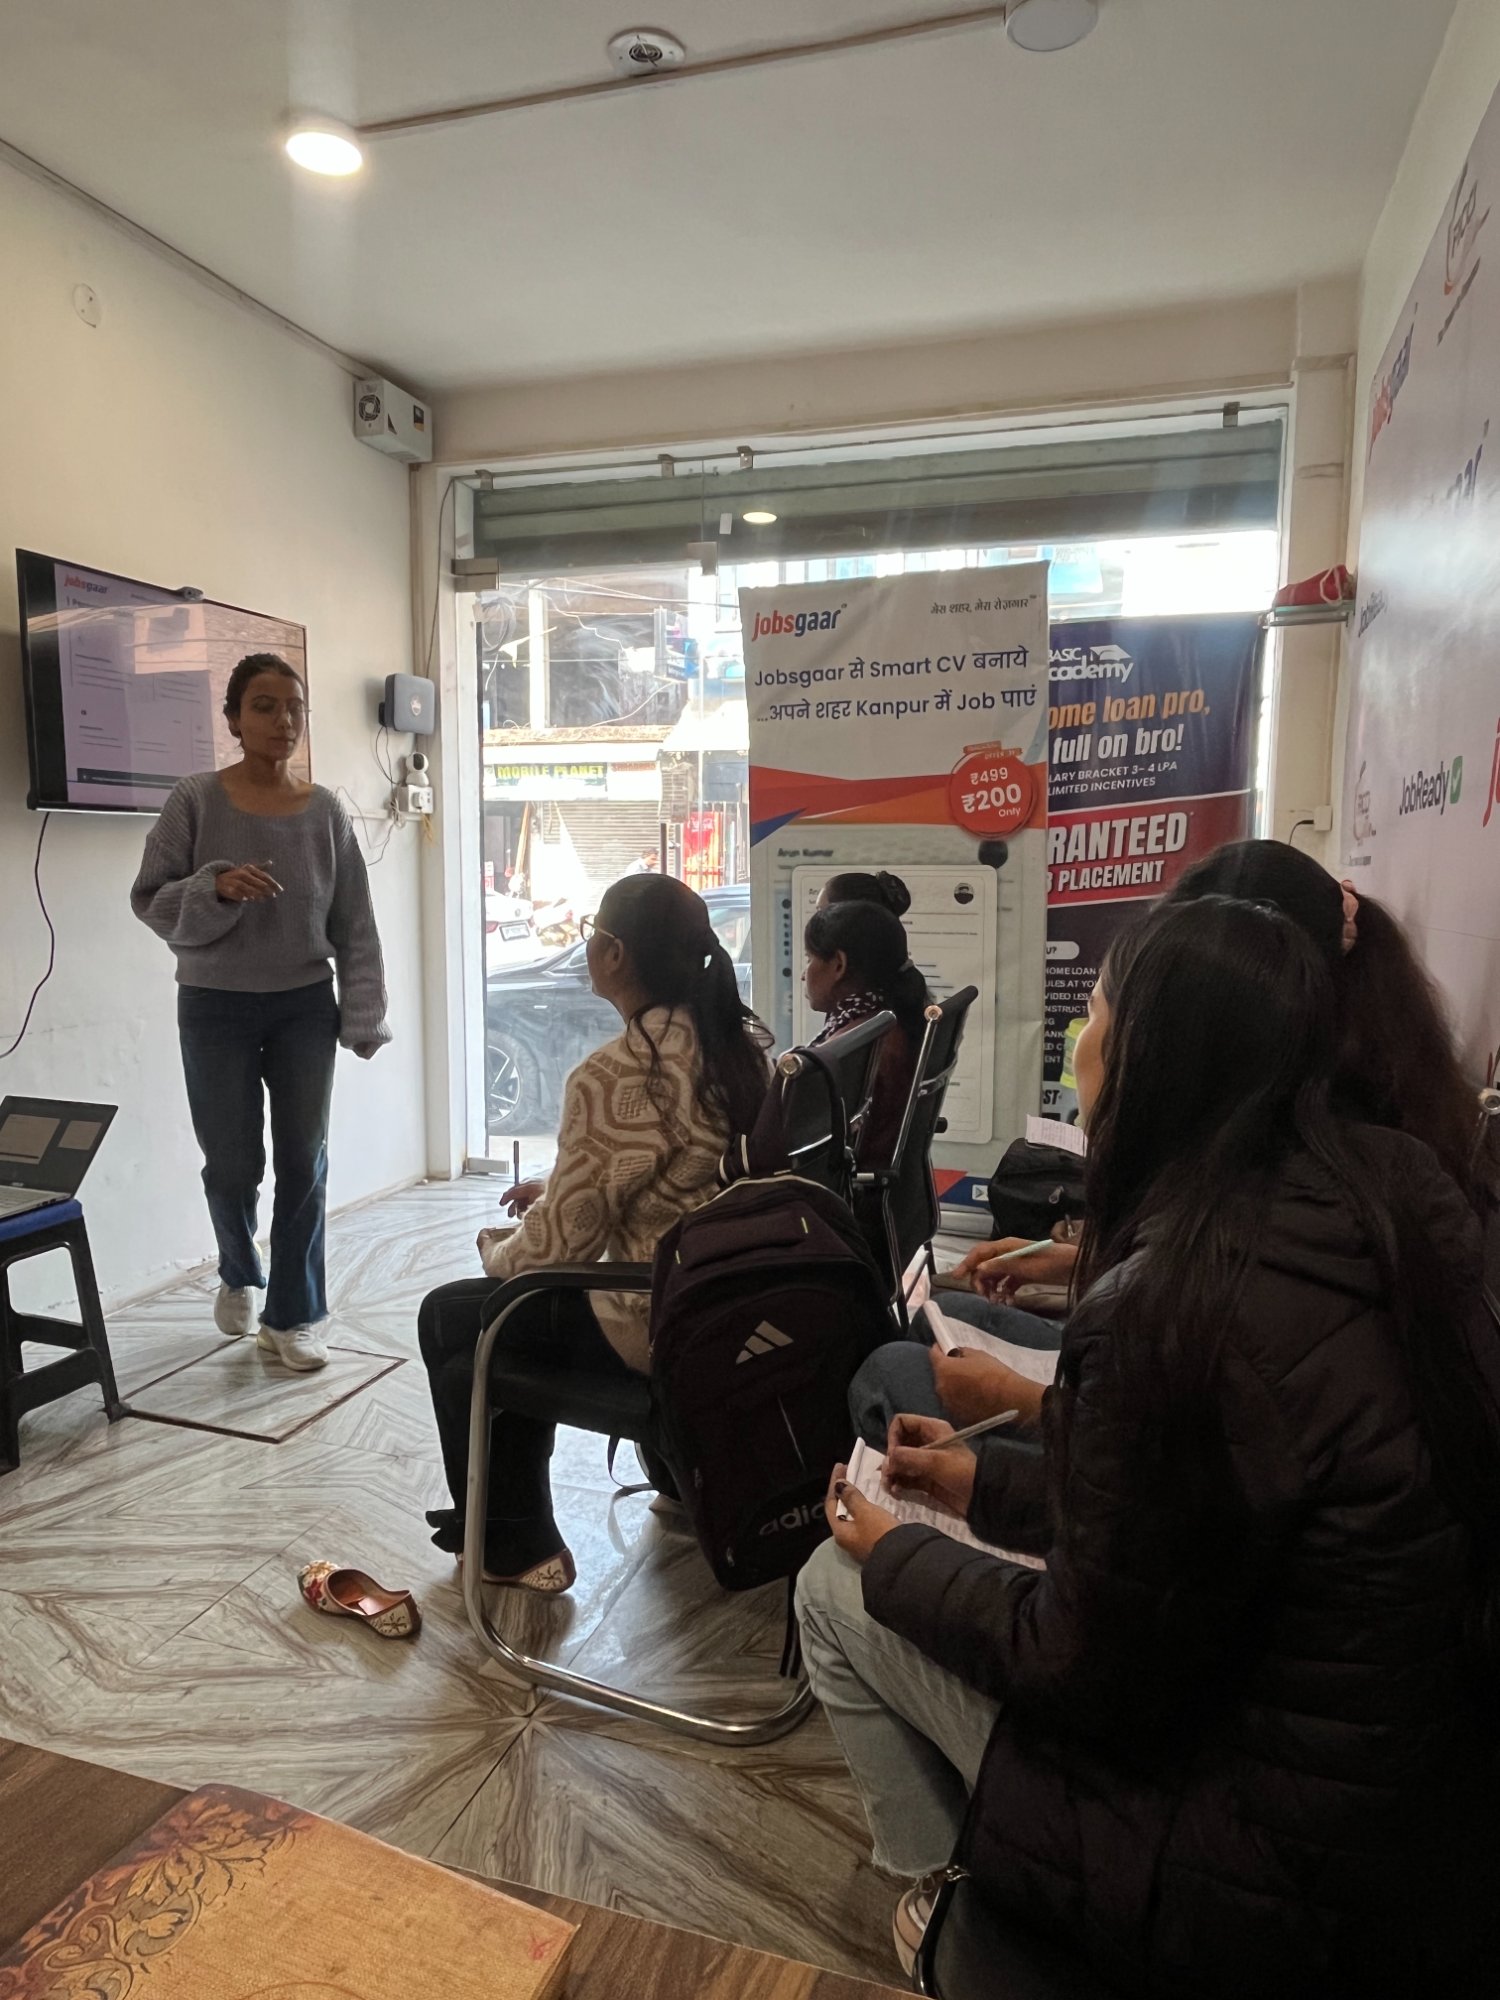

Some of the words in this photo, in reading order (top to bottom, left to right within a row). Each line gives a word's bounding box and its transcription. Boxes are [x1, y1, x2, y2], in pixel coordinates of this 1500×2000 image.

[751, 609, 842, 642] jobsgaar
[754, 668, 845, 688] Jobsgaar
[848, 657, 865, 679] से
[870, 657, 932, 677] Smart
[937, 655, 966, 673] CV
[972, 645, 1029, 669] बनाये
[816, 700, 852, 719] शहर
[857, 699, 929, 719] Kanpur
[934, 688, 953, 710] में
[957, 692, 995, 710] Job
[1001, 684, 1037, 707] पाएं
[1102, 695, 1156, 723] loan
[1161, 688, 1210, 719] pro,
[1052, 734, 1092, 764] full
[1097, 734, 1129, 759] on
[1135, 724, 1185, 756] bro!
[497, 765, 549, 778] MOBILE
[553, 764, 604, 778] PLANET
[970, 767, 1008, 785] ₹499
[1078, 766, 1129, 780] BRACKET
[1148, 763, 1155, 773] 4
[1158, 760, 1178, 772] LPA
[1091, 776, 1156, 792] INCENTIVES
[961, 784, 1022, 813] ₹200
[1399, 760, 1450, 816] JobReady
[999, 807, 1021, 818] Only
[1048, 812, 1187, 865] RANTEED
[1058, 860, 1165, 892] PLACEMENT
[1067, 980, 1078, 988] AT
[1071, 967, 1096, 975] LOAN
